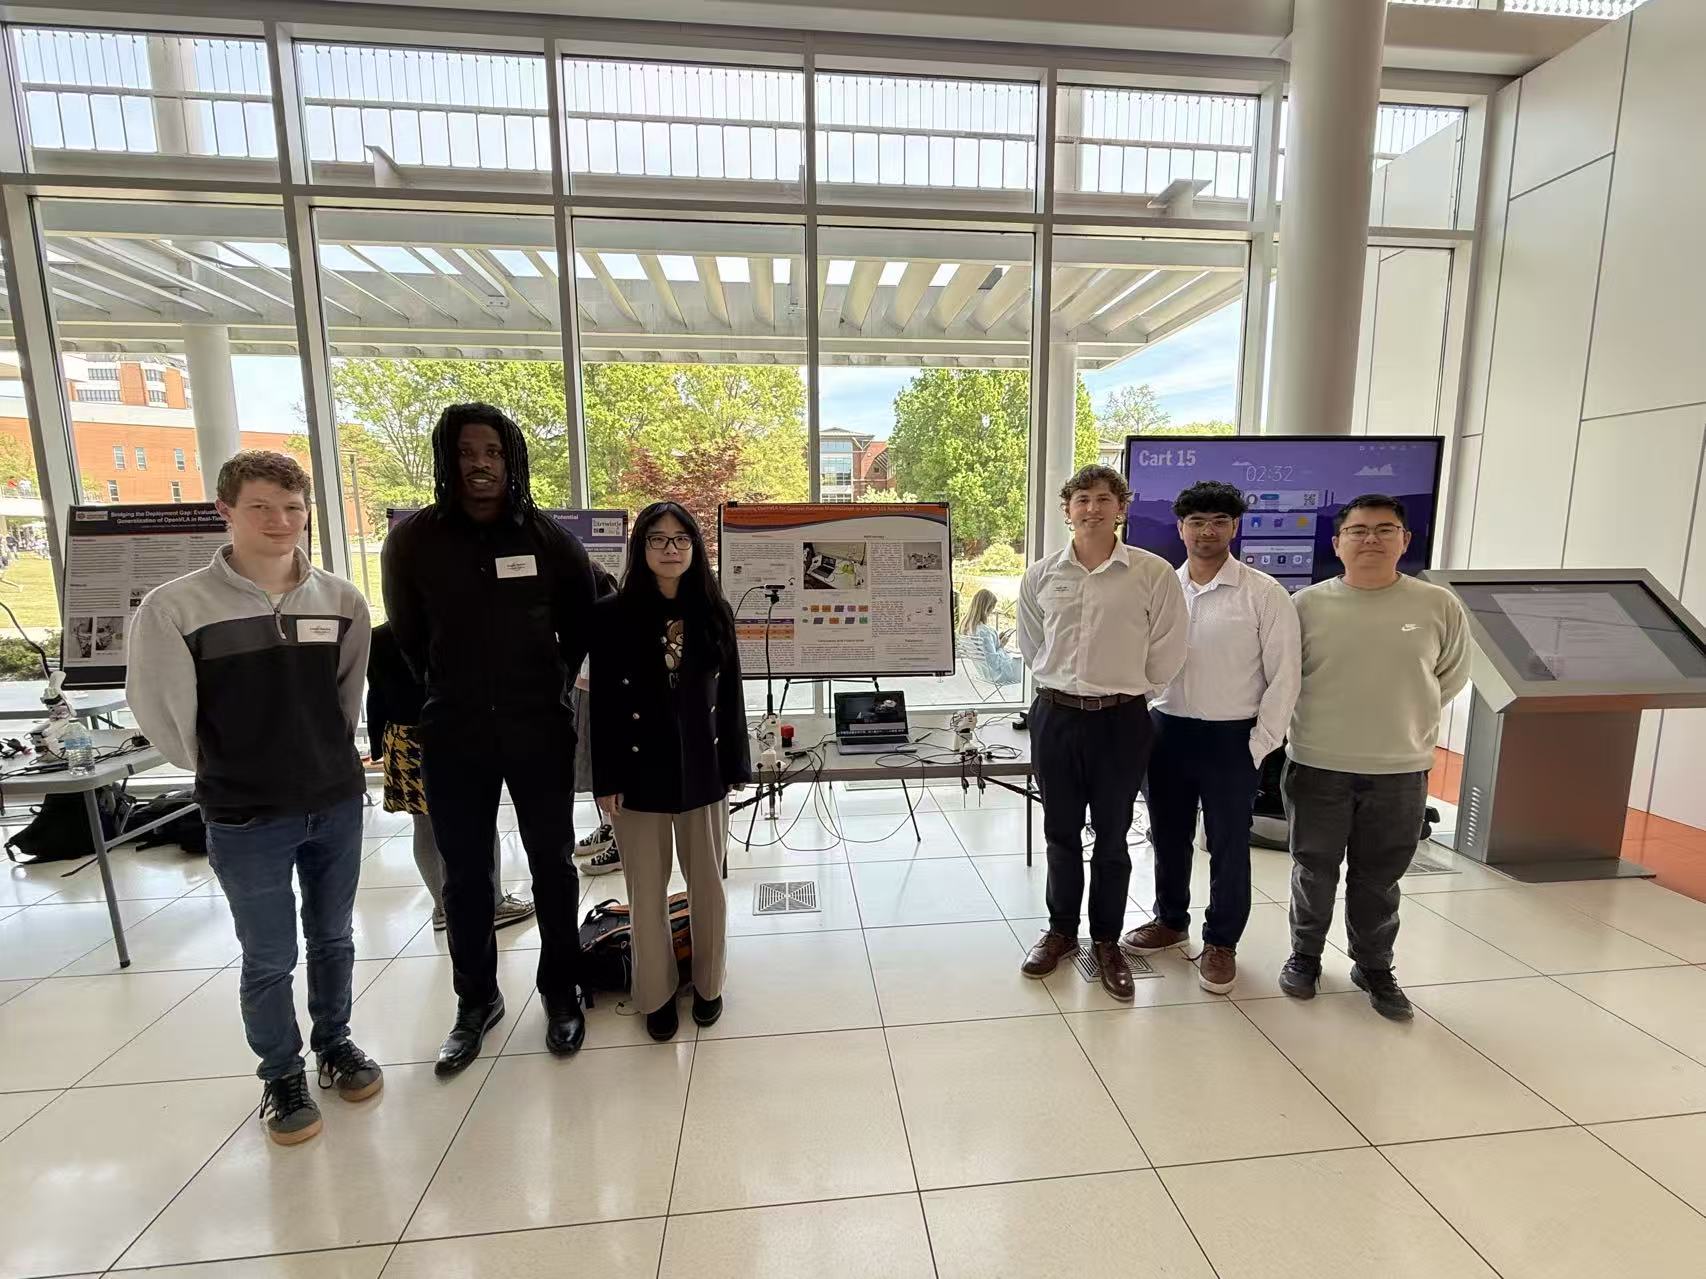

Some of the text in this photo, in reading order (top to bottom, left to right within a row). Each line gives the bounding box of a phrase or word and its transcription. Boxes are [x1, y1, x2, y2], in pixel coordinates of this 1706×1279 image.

[1139, 449, 1196, 466] Cart 15
[1247, 465, 1293, 481] 02:32
